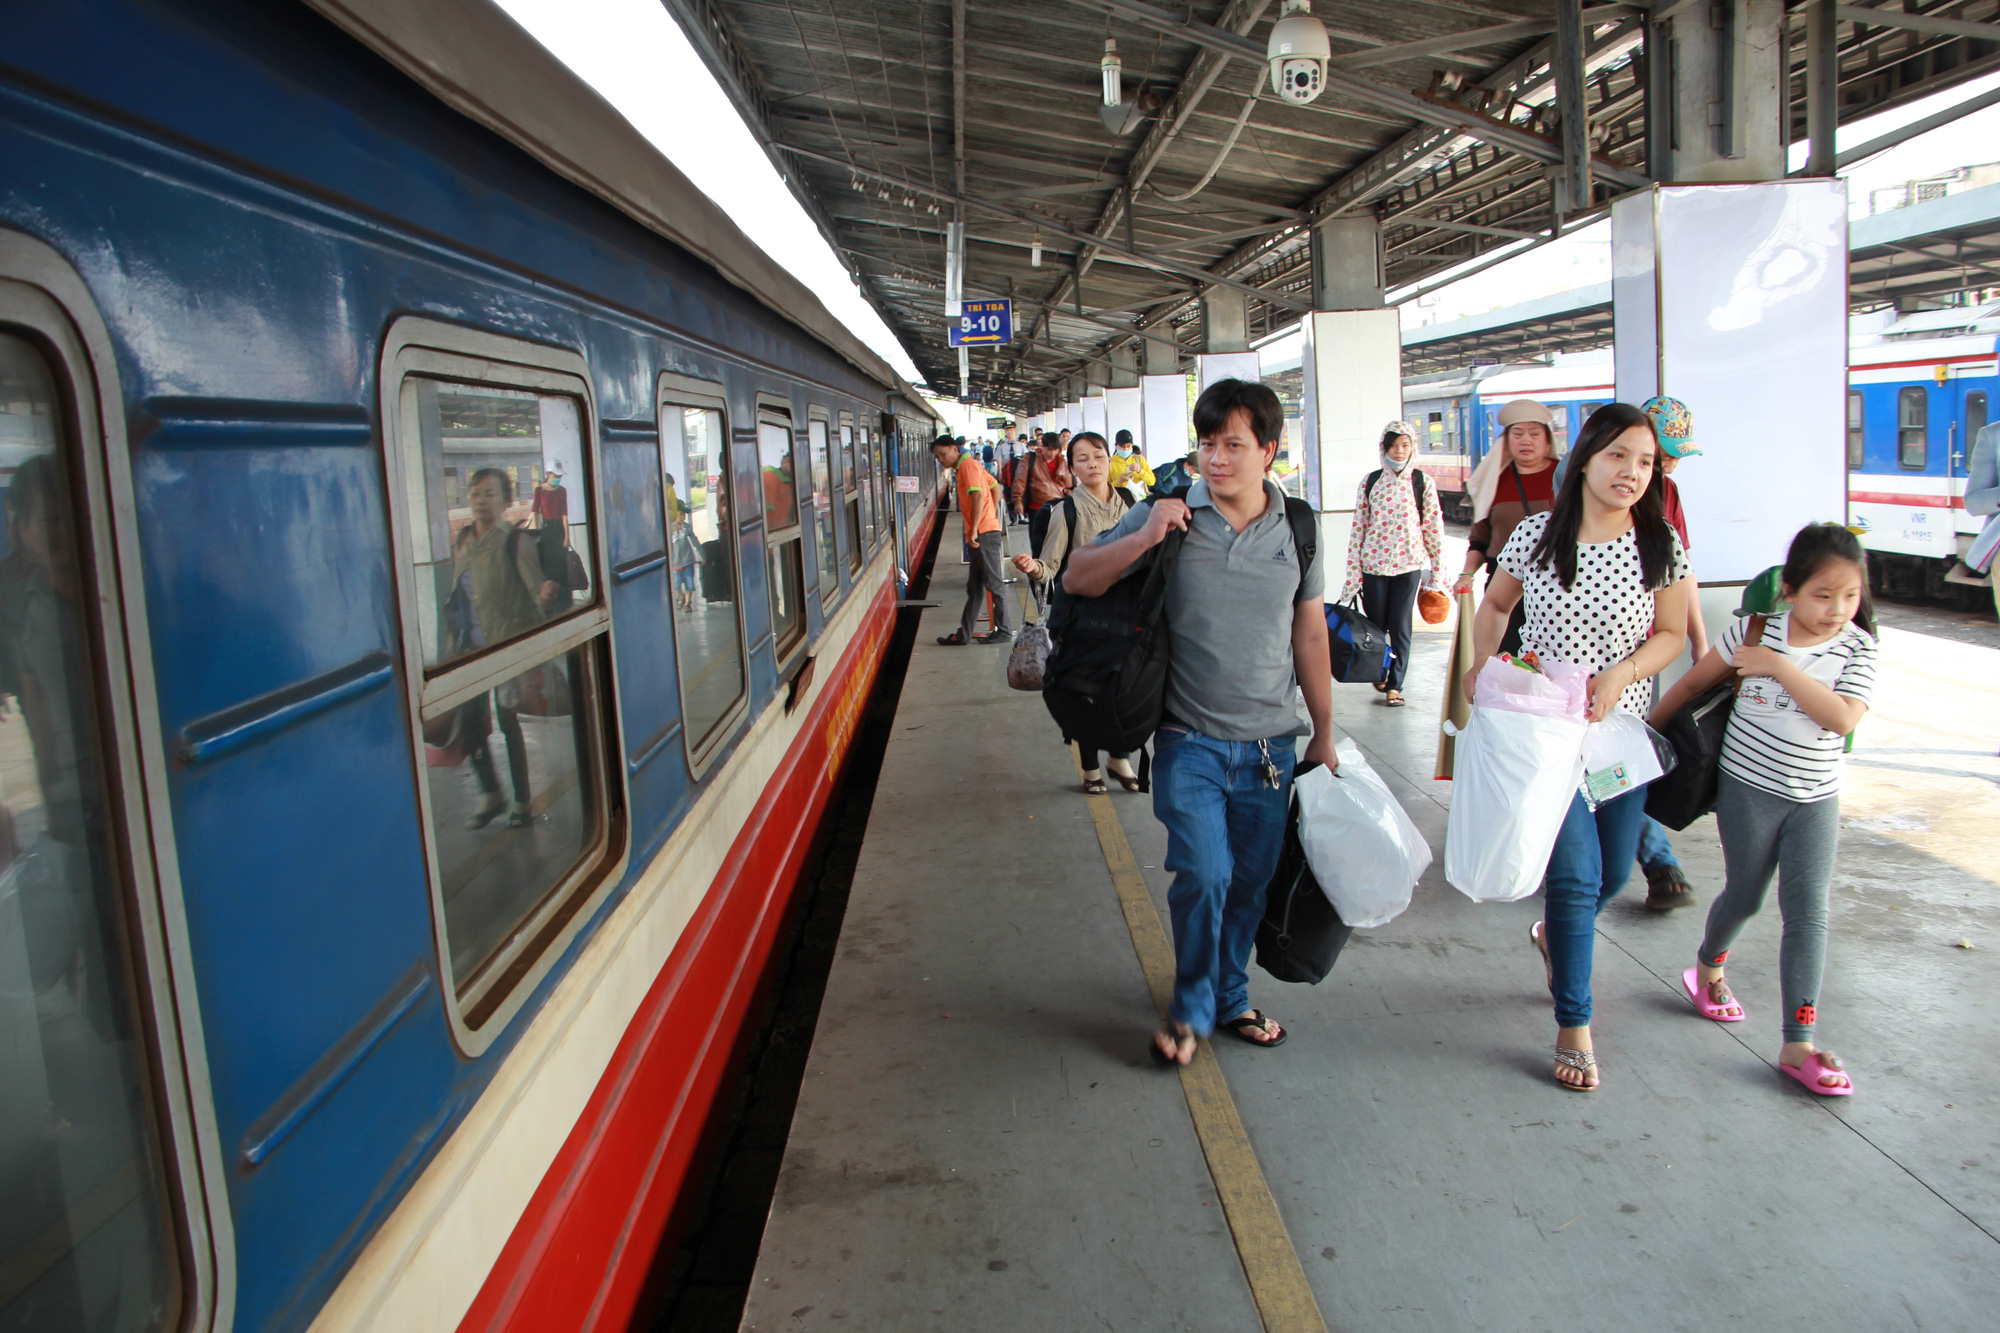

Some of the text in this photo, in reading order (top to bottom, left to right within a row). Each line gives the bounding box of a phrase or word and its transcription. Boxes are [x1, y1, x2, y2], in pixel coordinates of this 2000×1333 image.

[967, 303, 1005, 312] TRÍ TOA
[960, 315, 1000, 333] 9-10
[910, 481, 916, 489] 9
[1910, 512, 1927, 524] VNR
